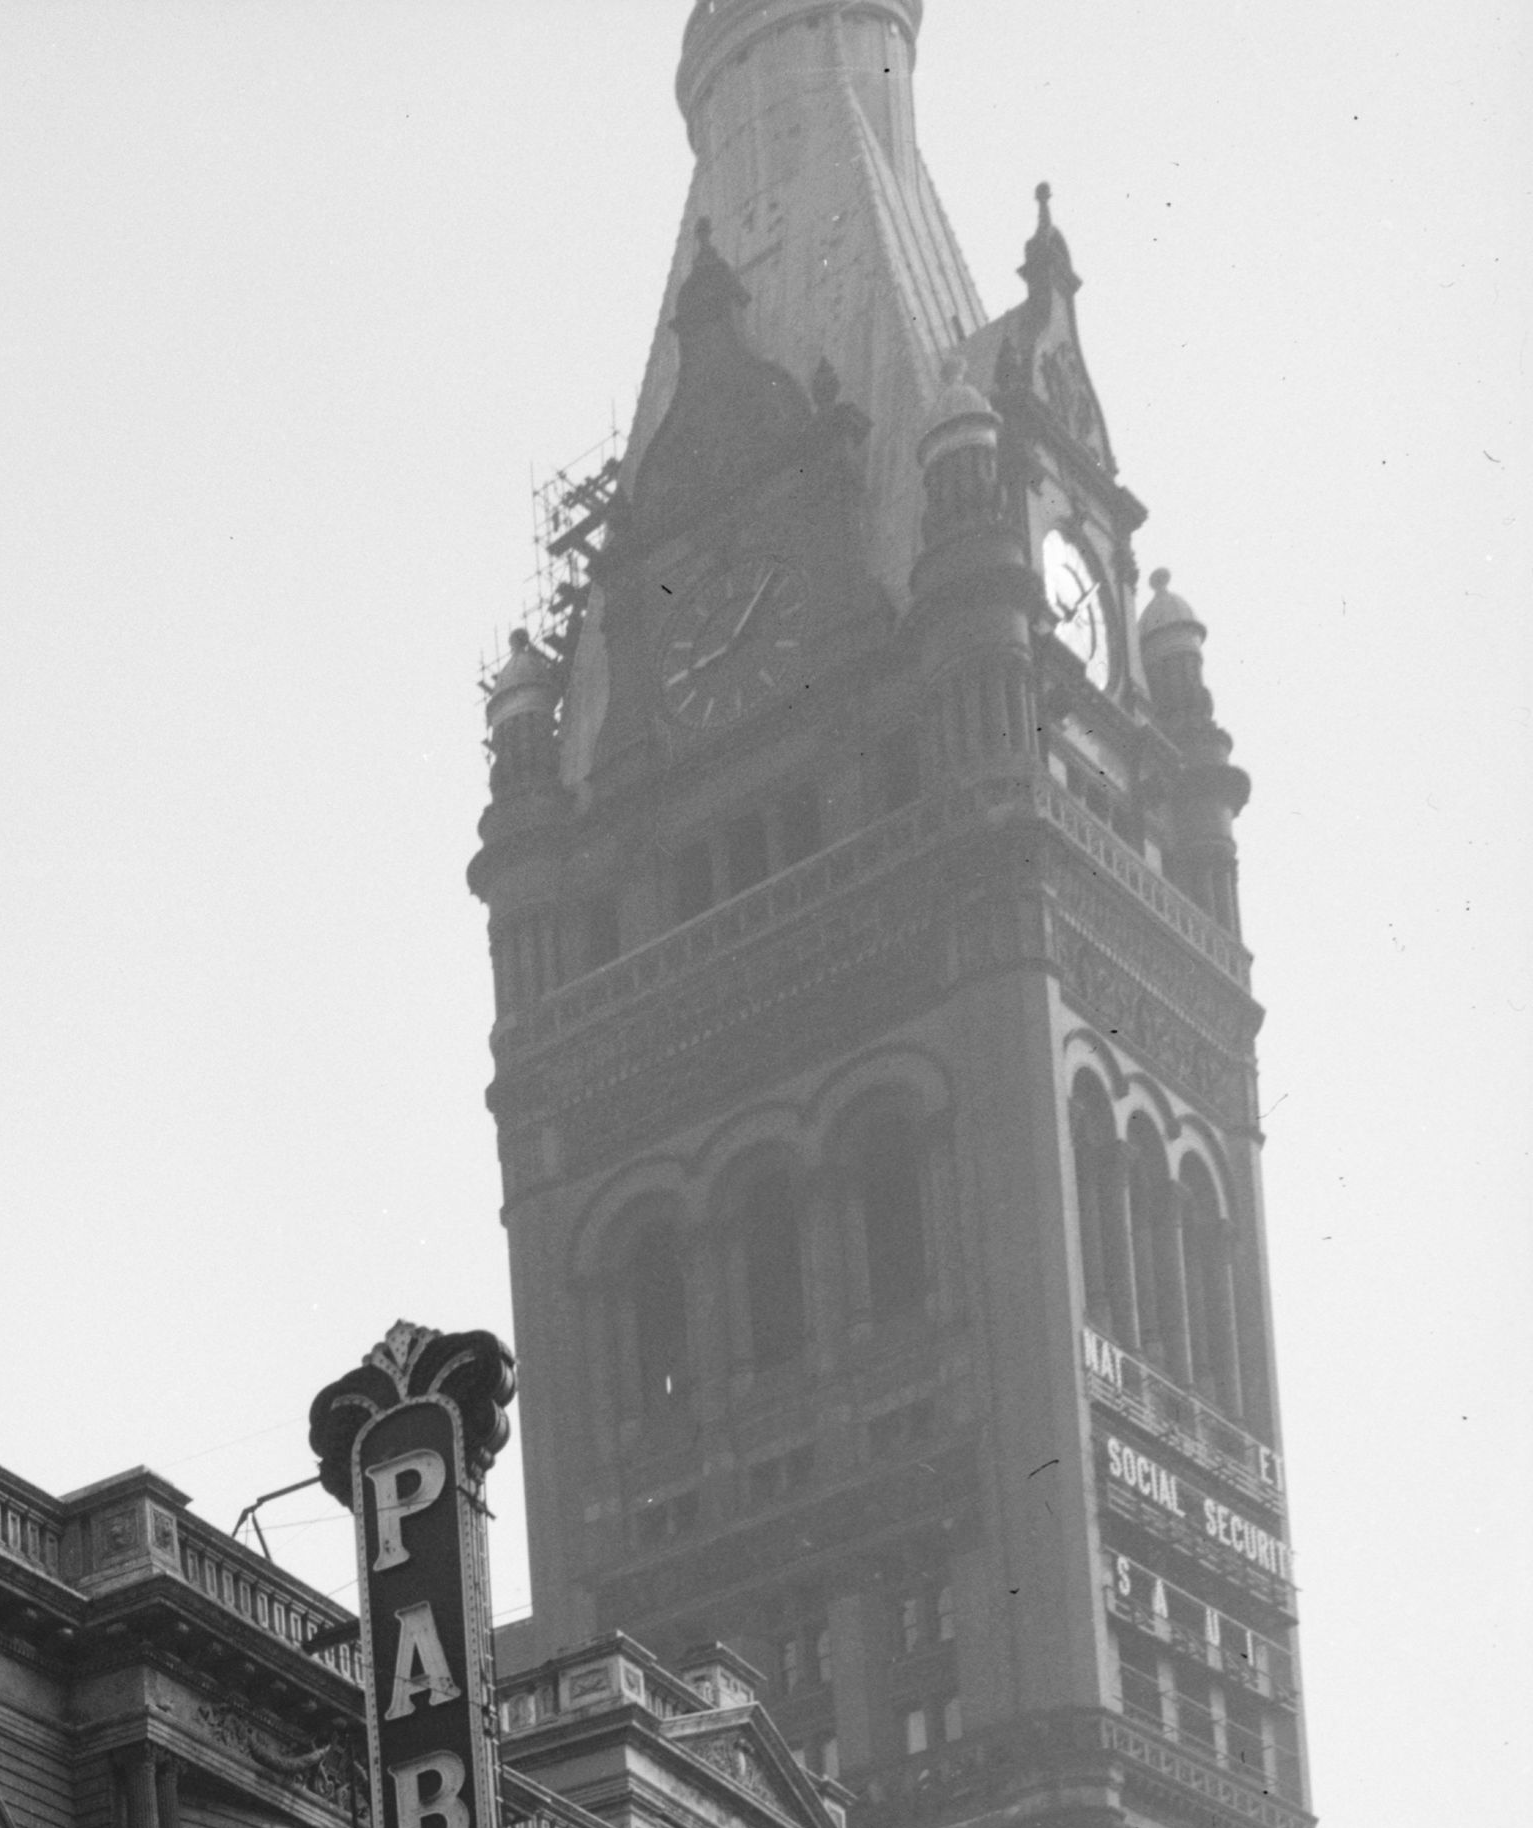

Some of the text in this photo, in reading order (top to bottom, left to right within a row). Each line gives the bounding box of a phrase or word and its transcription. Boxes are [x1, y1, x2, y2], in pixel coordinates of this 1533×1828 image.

[1083, 1326, 1124, 1390] NAT
[1107, 1437, 1295, 1580] SOCIAL SECURIT
